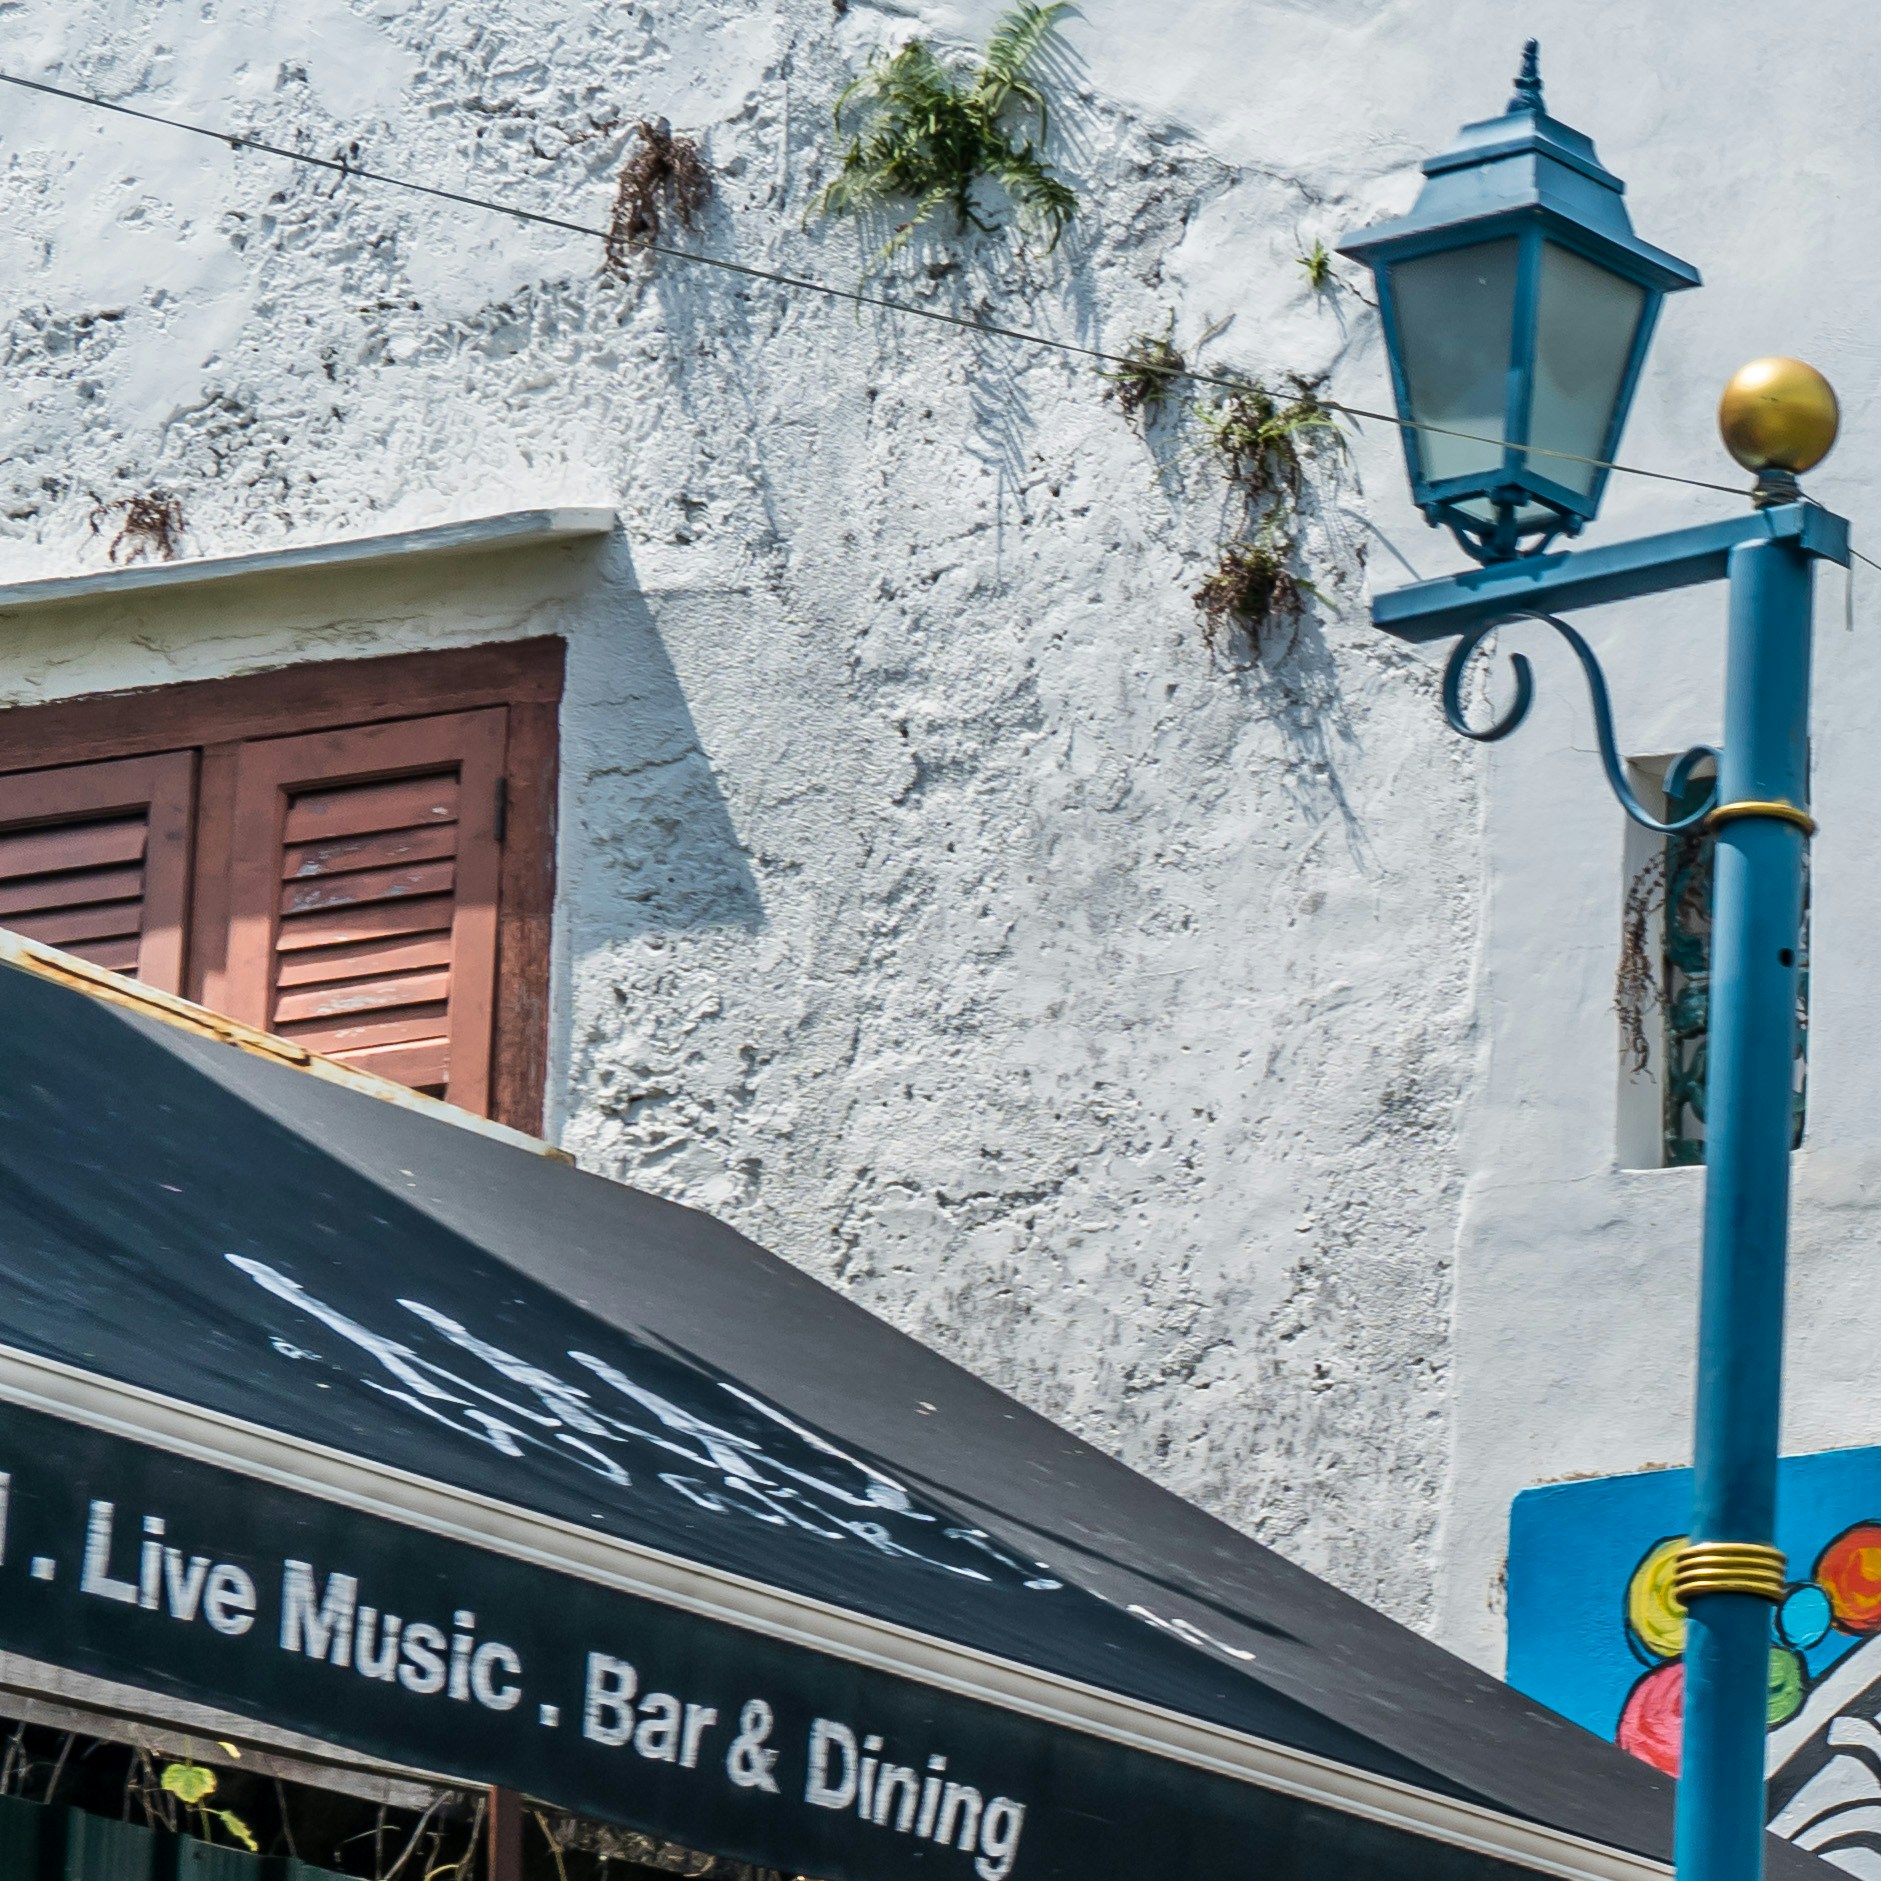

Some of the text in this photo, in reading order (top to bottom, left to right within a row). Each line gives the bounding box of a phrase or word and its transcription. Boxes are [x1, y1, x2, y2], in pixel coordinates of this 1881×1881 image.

[80, 1500, 257, 1635] Live
[280, 1559, 522, 1710] Music
[583, 1651, 718, 1768] Bar
[726, 1699, 781, 1794] &
[804, 1717, 1027, 1881] Dining
